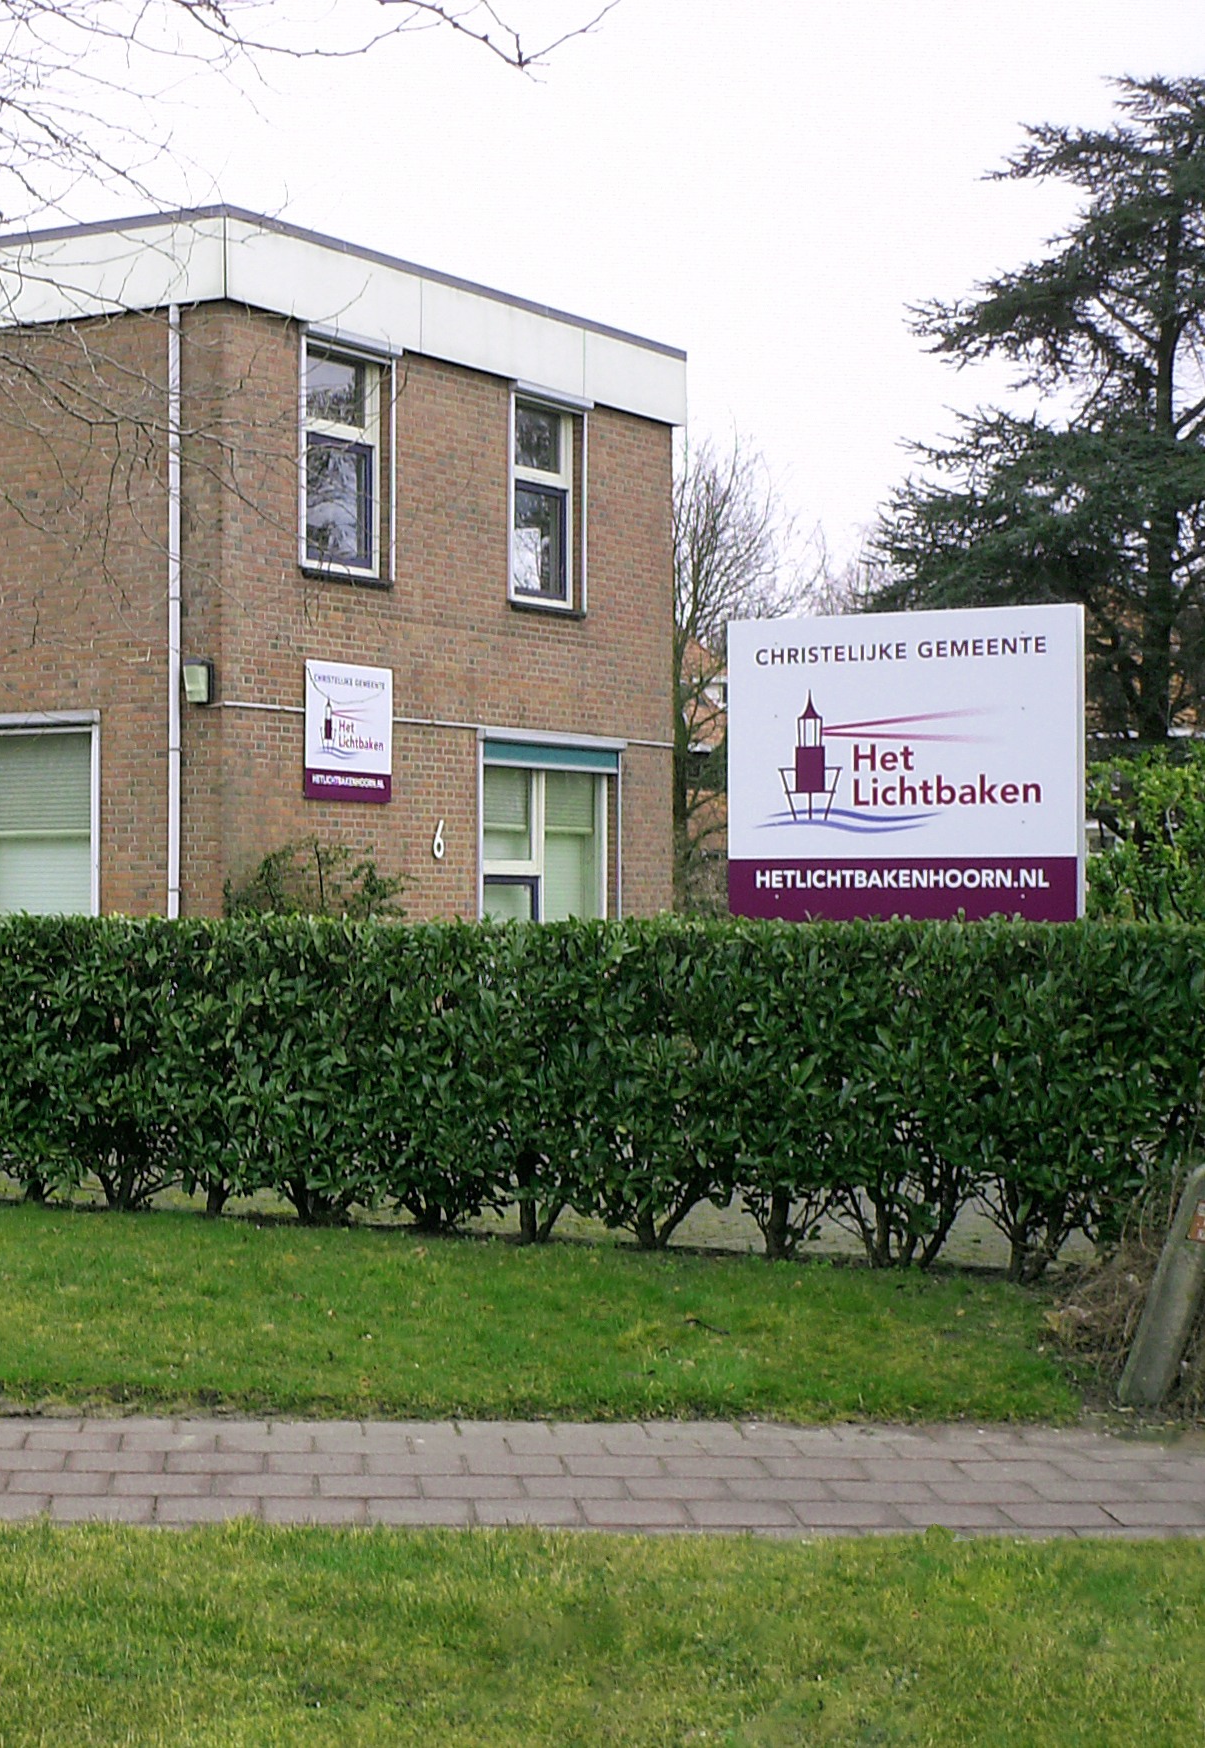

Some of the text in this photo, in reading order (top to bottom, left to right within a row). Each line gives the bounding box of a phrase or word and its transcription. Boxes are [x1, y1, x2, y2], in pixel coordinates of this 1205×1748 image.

[755, 636, 1047, 666] CHRISTELIJKE GEMEENTE
[338, 720, 355, 734] Het
[338, 736, 384, 751] Lichtbaken
[853, 744, 914, 771] Het
[853, 774, 1042, 806] Lichtbaken
[433, 819, 445, 859] 6
[755, 868, 1050, 889] HETLICHTBAKENHOORN.NL
